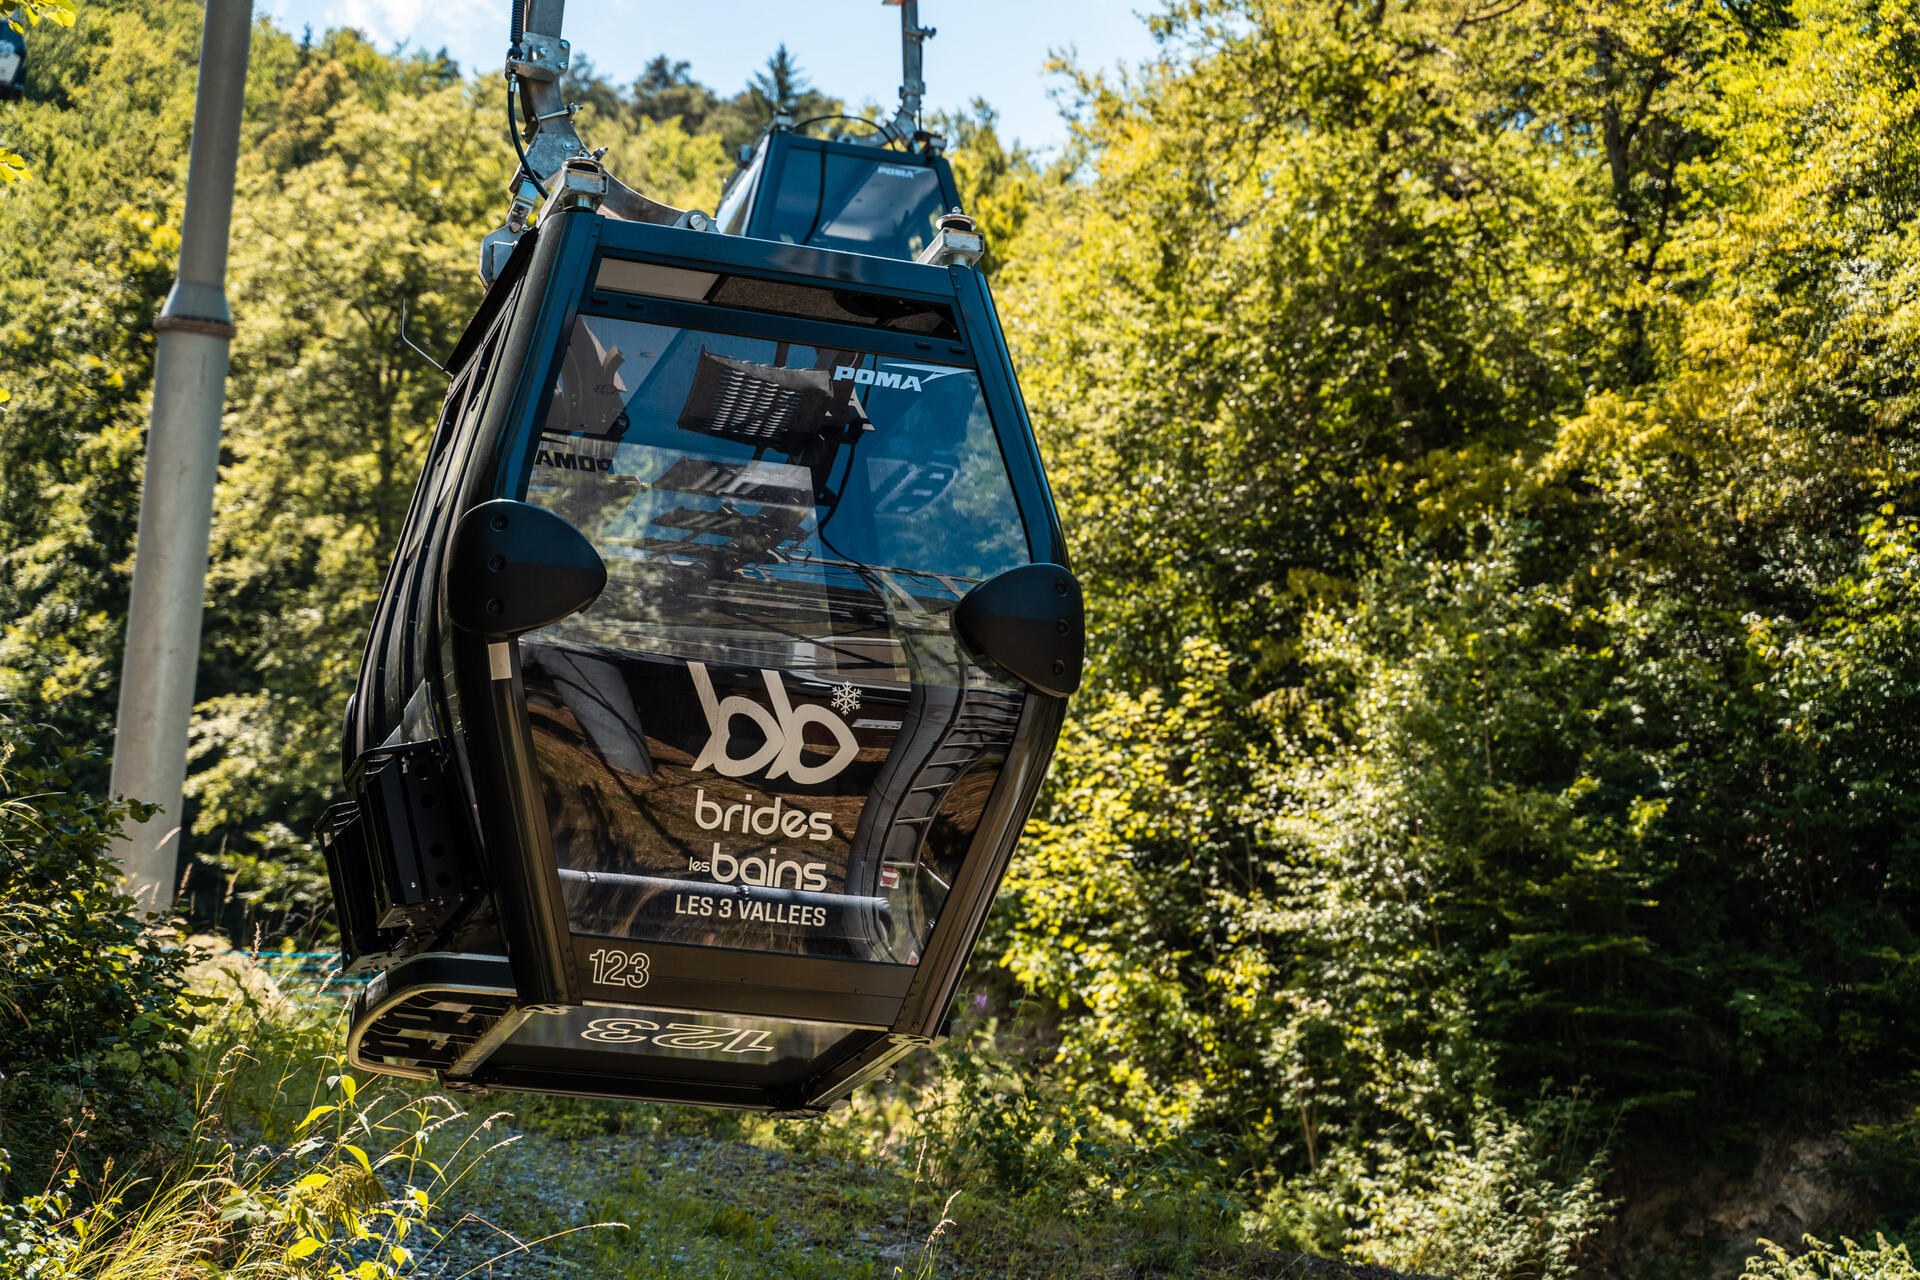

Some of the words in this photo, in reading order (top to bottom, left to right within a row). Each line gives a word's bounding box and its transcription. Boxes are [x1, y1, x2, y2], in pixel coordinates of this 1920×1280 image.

[833, 365, 922, 392] POMA
[695, 789, 833, 841] brides
[689, 856, 710, 873] les
[711, 842, 827, 892] bains
[675, 894, 713, 917] LES
[718, 898, 733, 919] 3
[738, 899, 827, 927] VALLEES
[588, 949, 650, 989] 123
[580, 1017, 775, 1054] 123
